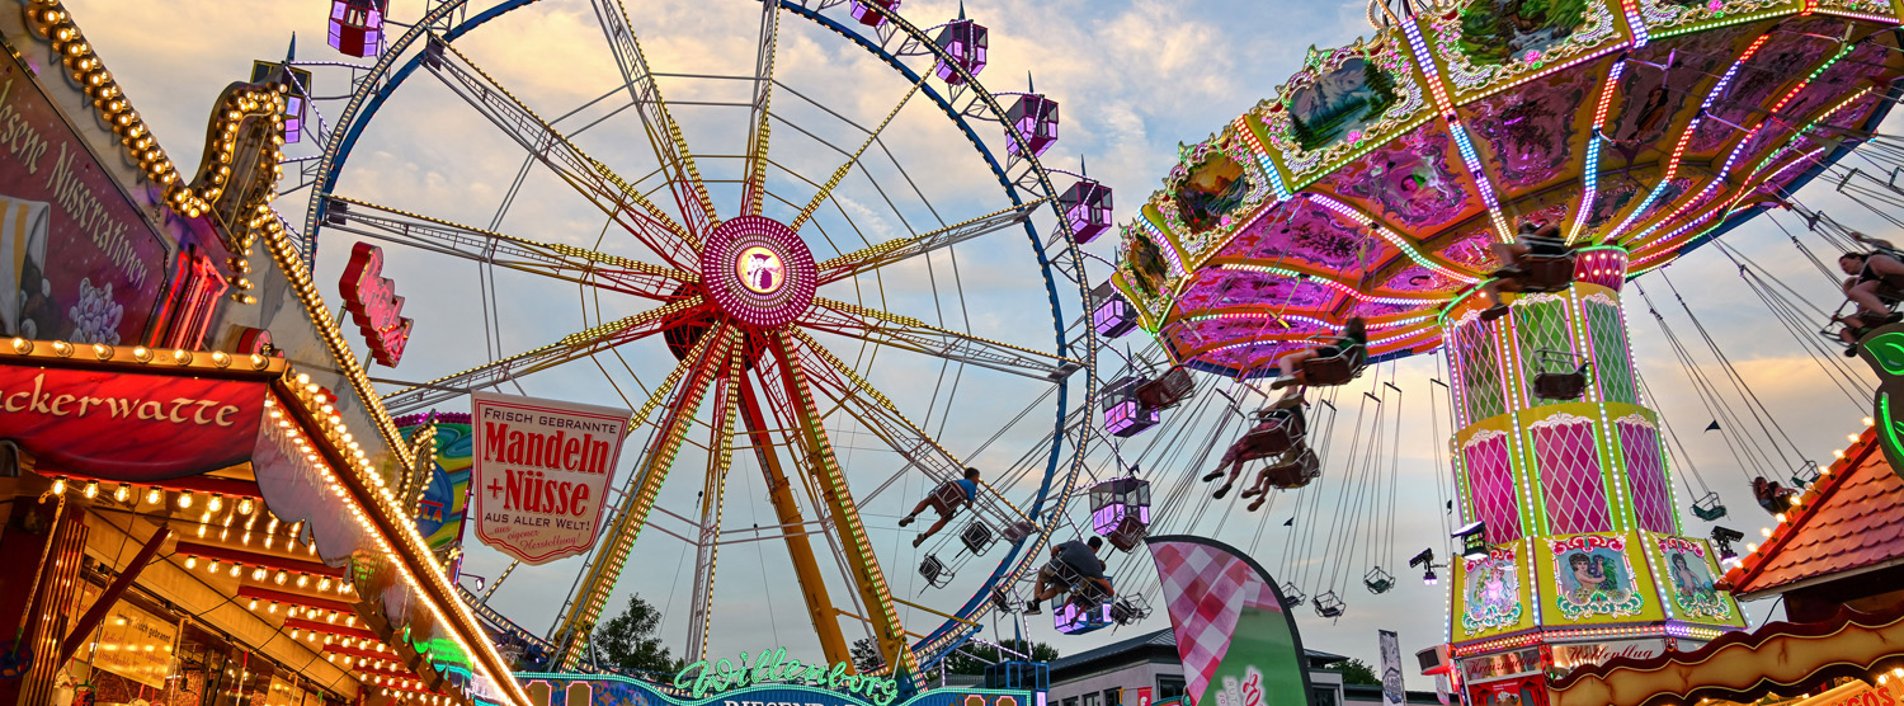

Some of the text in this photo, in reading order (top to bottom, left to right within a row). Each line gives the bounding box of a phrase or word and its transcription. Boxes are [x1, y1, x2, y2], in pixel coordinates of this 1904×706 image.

[0, 373, 239, 427] ckerwatte
[538, 415, 618, 434] GEBRANNTE
[484, 421, 610, 475] Mandeln
[484, 512, 510, 524] AUS
[513, 515, 551, 528] ALLER
[673, 646, 898, 706] Willenborg
